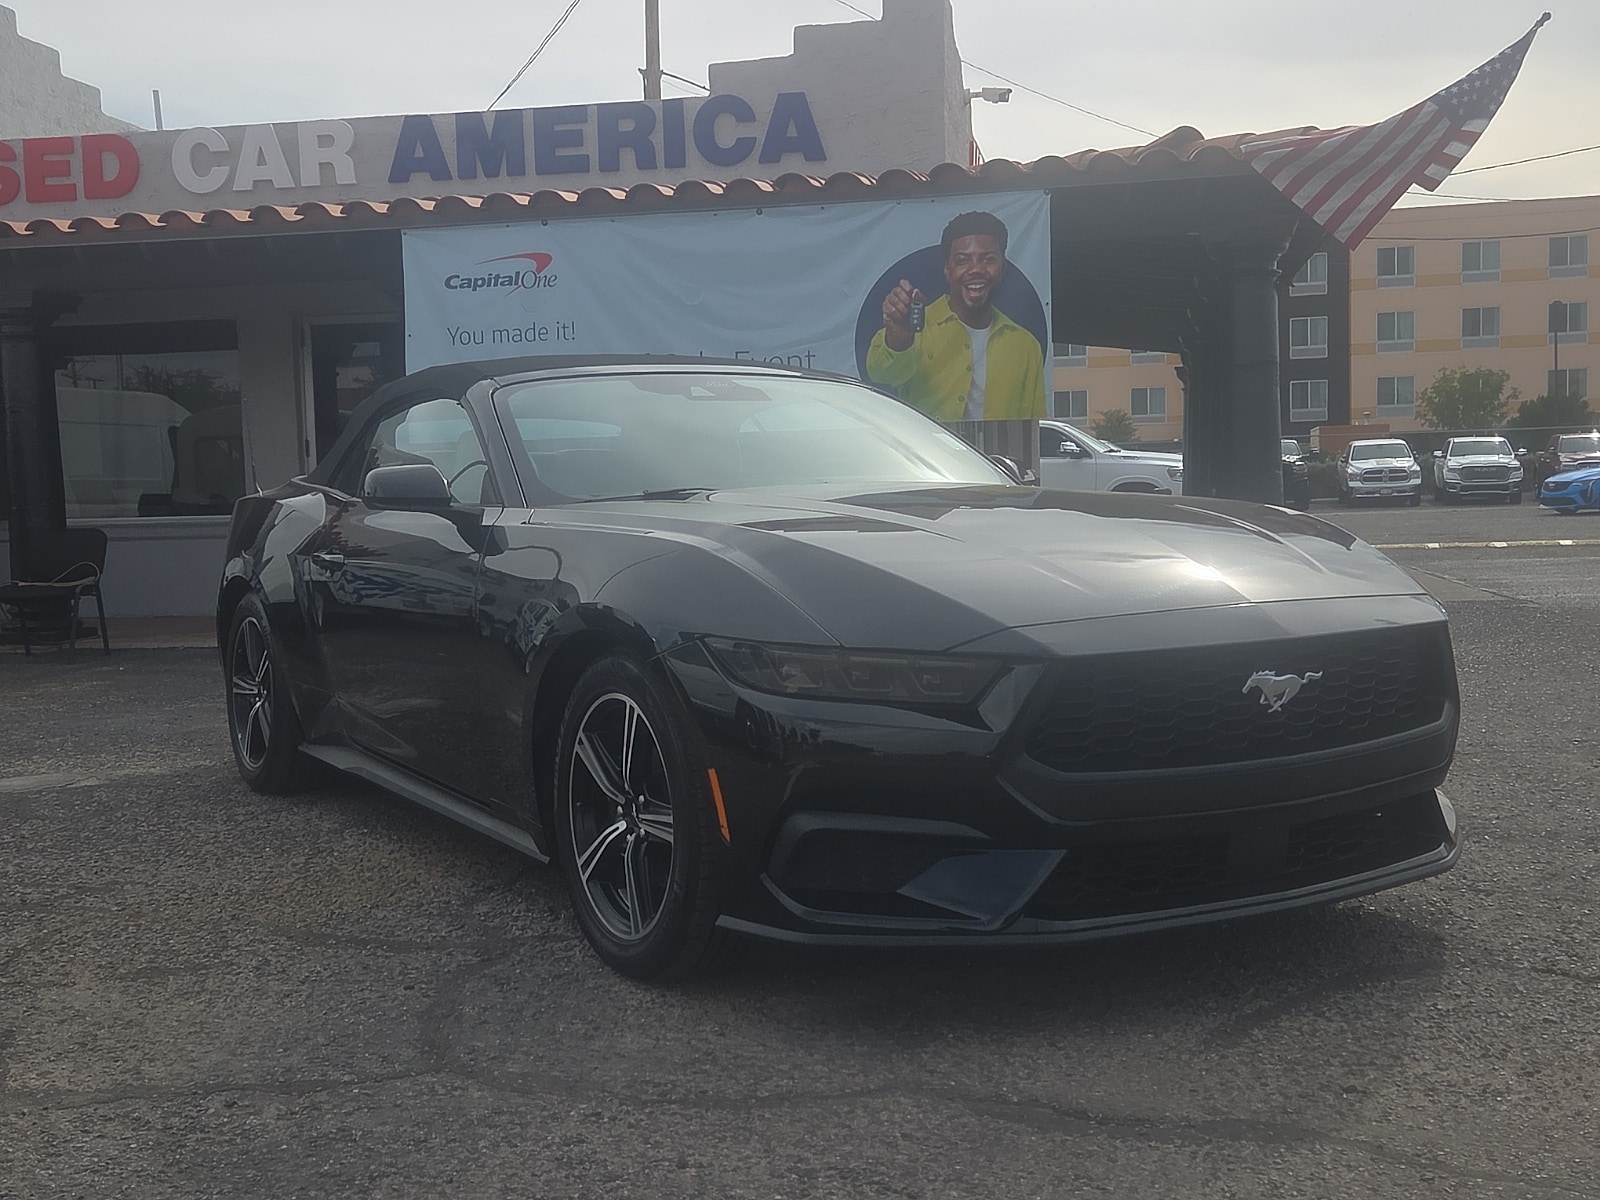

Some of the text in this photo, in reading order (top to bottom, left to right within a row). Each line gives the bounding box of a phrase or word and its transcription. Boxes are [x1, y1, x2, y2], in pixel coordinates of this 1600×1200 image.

[171, 119, 358, 194] CAR
[387, 91, 828, 184] AMERICA
[446, 321, 576, 346] You made it!
